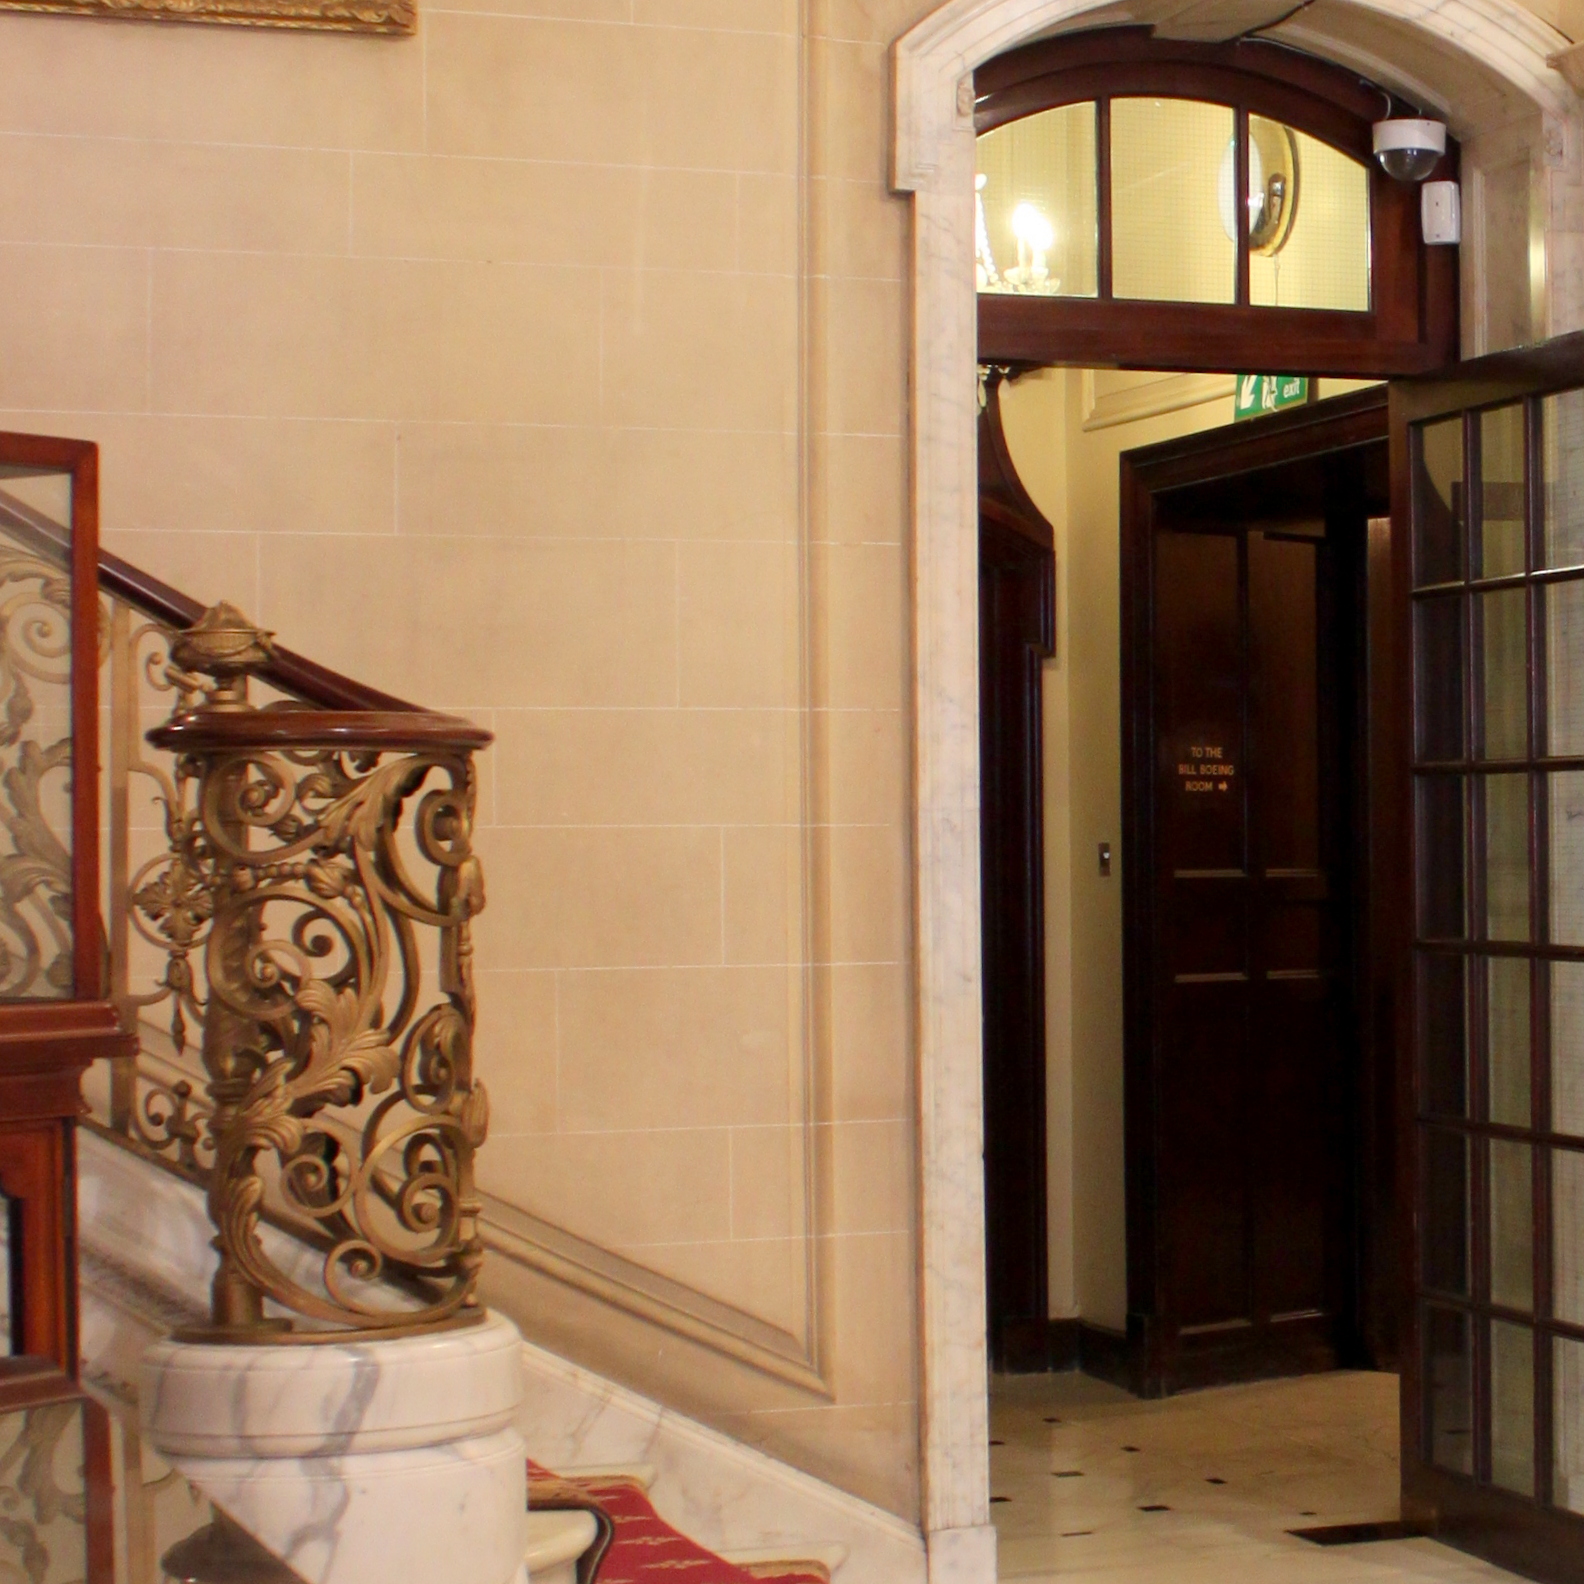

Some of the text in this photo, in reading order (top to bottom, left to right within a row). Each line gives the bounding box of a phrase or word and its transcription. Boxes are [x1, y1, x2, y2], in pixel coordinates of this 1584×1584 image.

[1283, 377, 1300, 398] exit
[1190, 746, 1223, 758] TO THE
[1178, 763, 1234, 775] BILL BOEING
[1185, 780, 1213, 792] ROOM
